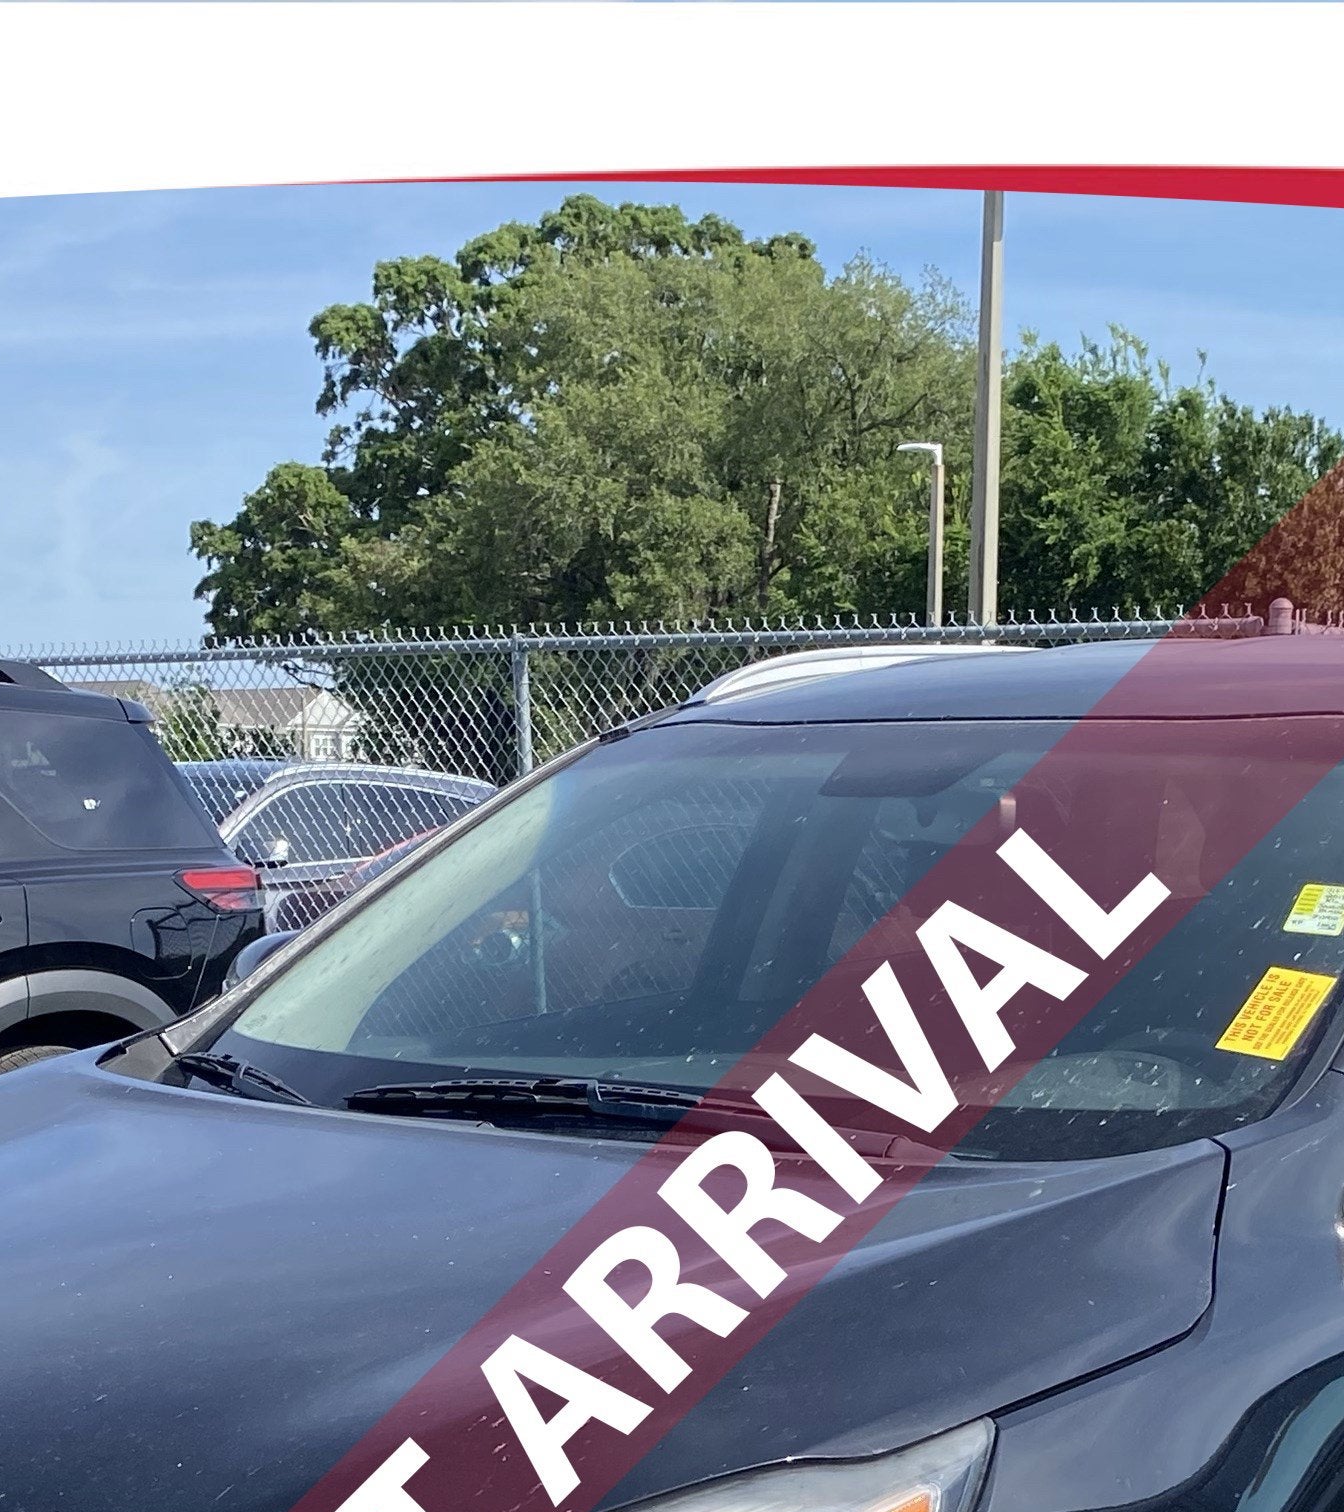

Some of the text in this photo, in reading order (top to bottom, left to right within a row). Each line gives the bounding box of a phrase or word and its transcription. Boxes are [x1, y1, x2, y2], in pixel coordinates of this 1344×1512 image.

[1223, 1021, 1247, 1042] THIS
[1240, 984, 1273, 1020] VEHICLE
[1268, 973, 1281, 983] IS
[1241, 980, 1292, 1042] NOT FOR SALE
